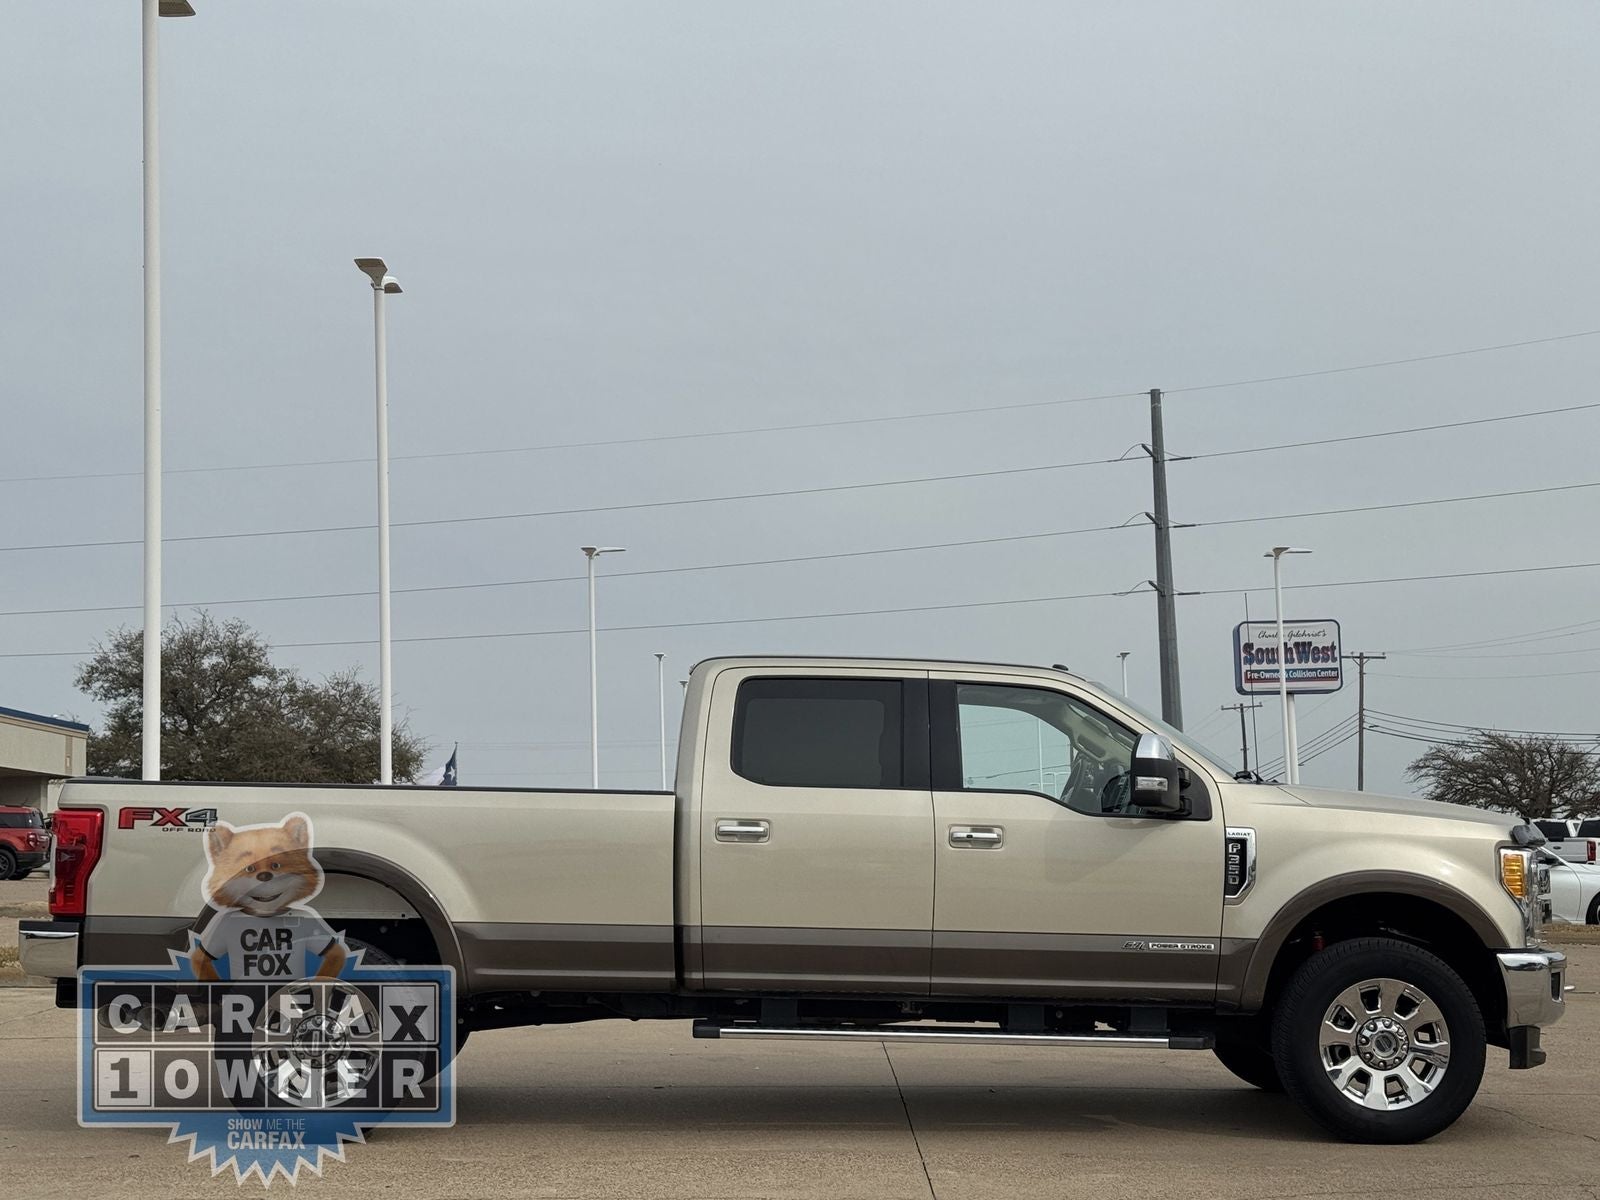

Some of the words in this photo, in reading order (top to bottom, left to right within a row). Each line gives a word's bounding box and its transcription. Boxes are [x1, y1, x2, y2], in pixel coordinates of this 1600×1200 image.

[1258, 629, 1285, 639] Charl
[1242, 641, 1338, 665] SouhWest
[1247, 670, 1282, 679] Pre-Owne
[1289, 669, 1317, 678] Collision
[1317, 669, 1338, 677] Center
[118, 806, 218, 829] FX4
